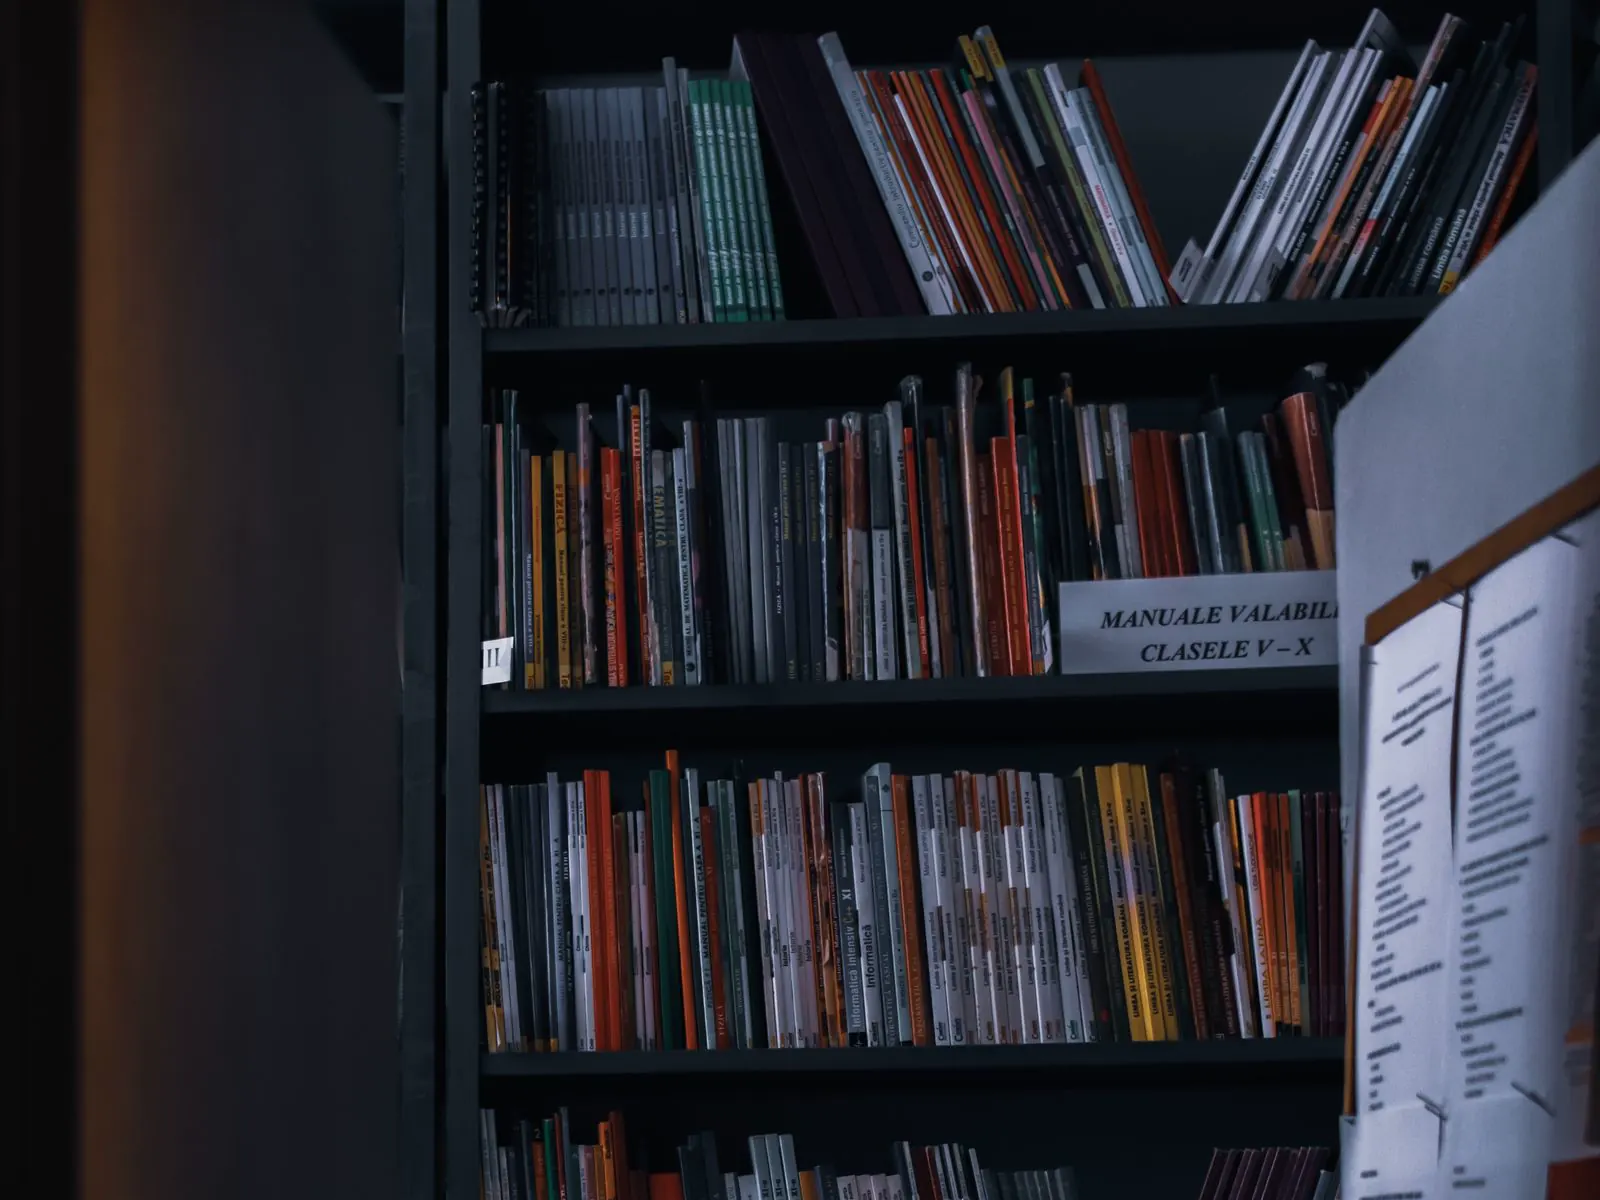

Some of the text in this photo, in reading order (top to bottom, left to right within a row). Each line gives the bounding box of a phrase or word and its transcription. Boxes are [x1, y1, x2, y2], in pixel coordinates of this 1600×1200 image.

[1431, 248, 1456, 279] Limba
[1100, 606, 1222, 629] MANUALE
[1140, 640, 1250, 662] CLASELE
[1256, 639, 1275, 658] V
[1294, 637, 1315, 656] X
[862, 924, 877, 988] Informatică
[1124, 940, 1136, 984] LITERATURA
[848, 969, 862, 1028] Informatică
[1130, 993, 1140, 1018] LIMBA
